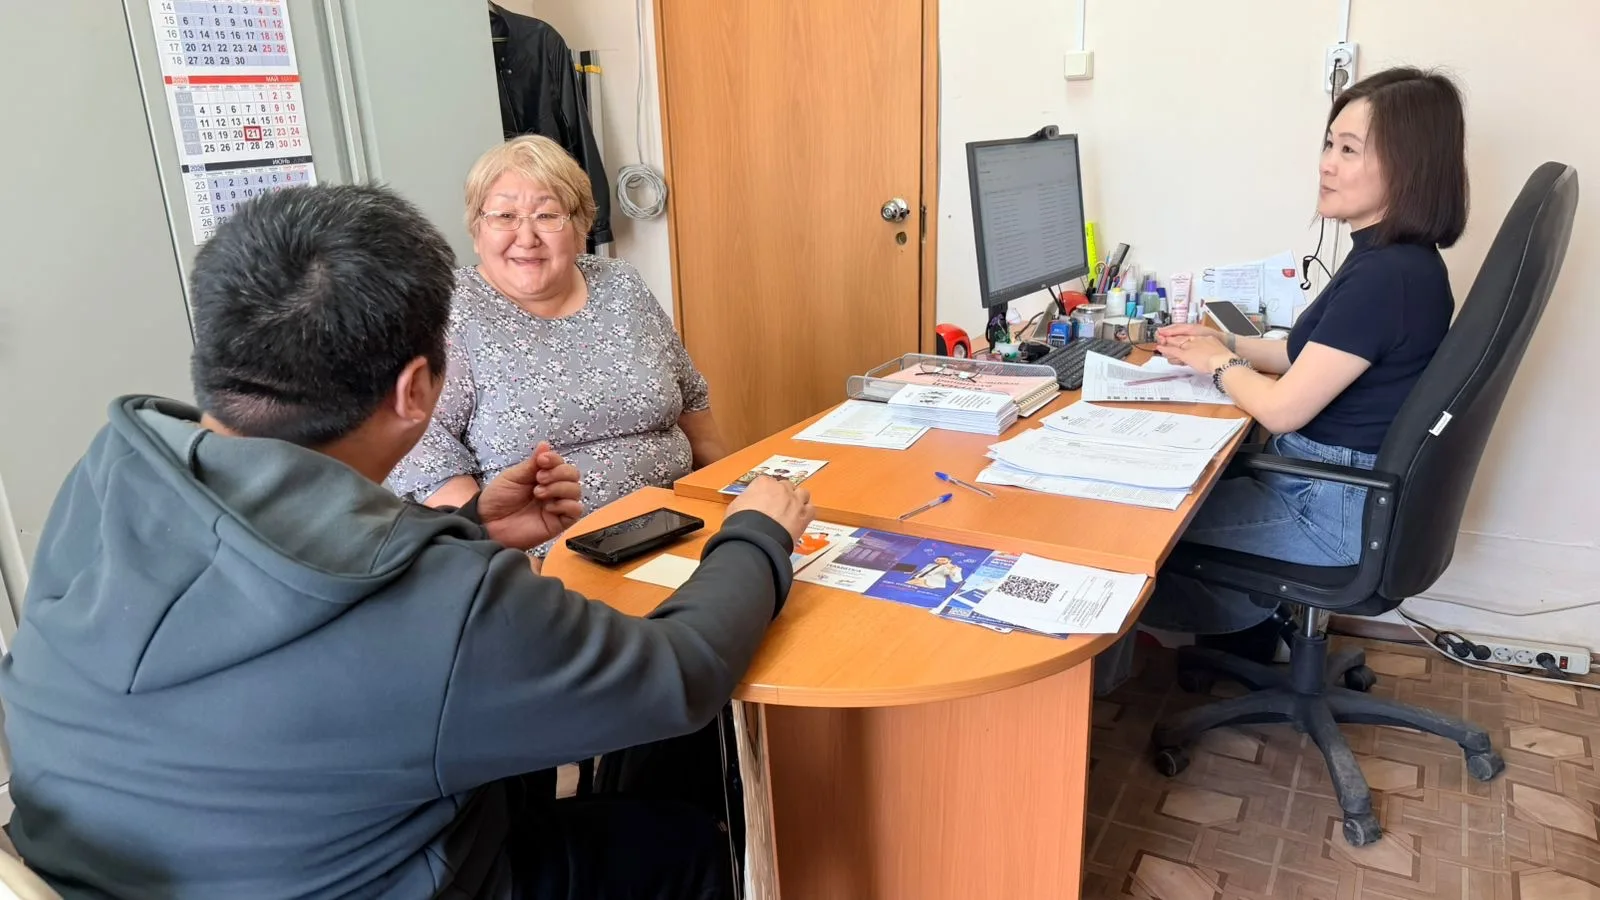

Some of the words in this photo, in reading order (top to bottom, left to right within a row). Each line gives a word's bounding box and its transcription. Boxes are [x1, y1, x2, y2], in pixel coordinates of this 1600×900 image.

[161, 2, 172, 11] 14
[213, 5, 217, 13] 1
[228, 6, 233, 14] 2
[243, 6, 248, 14] 3
[258, 7, 263, 16] 4
[272, 8, 278, 16] 5
[165, 15, 175, 25] 15
[183, 17, 189, 25] 6
[199, 17, 204, 25] 7
[215, 18, 220, 26] 8
[230, 18, 236, 26] 9
[243, 19, 253, 27] 10
[258, 19, 267, 28] 11
[273, 20, 282, 28] 12
[167, 29, 177, 38] 16
[183, 30, 194, 39] 13
[199, 30, 210, 39] 14
[215, 31, 225, 39] 15
[230, 31, 241, 39] 16
[245, 32, 255, 40] 17
[261, 32, 270, 40] 18
[274, 32, 284, 41] 19
[169, 43, 179, 52] 17
[186, 43, 196, 52] 20
[202, 44, 212, 52] 21
[217, 44, 228, 52] 22
[233, 44, 243, 52] 23
[248, 44, 258, 52] 24
[262, 44, 272, 52] 25
[276, 44, 286, 53] 26
[172, 56, 182, 65] 18
[188, 56, 198, 65] 27
[204, 56, 215, 65] 28
[220, 57, 230, 65] 29
[235, 57, 245, 65] 30
[259, 92, 263, 100] 1
[272, 92, 278, 100] 2
[286, 91, 291, 99] 3
[199, 106, 205, 114] 4
[216, 106, 221, 114] 5
[231, 105, 236, 113] 6
[246, 105, 251, 113] 7
[260, 104, 266, 112] 8
[274, 104, 279, 112] 9
[200, 119, 209, 128] 11
[216, 118, 226, 127] 12
[231, 118, 241, 126] 13
[246, 117, 256, 125] 14
[260, 116, 270, 124] 15
[275, 115, 284, 124] 16
[288, 115, 297, 123] 17
[202, 131, 213, 140] 18
[218, 131, 228, 139] 19
[233, 130, 243, 138] 20
[248, 129, 258, 138] 21
[263, 128, 272, 136] 22
[277, 128, 286, 136] 23
[290, 127, 300, 135] 24
[204, 144, 215, 153] 25
[220, 143, 231, 151] 26
[235, 142, 245, 150] 27
[250, 141, 260, 150] 28
[265, 140, 274, 149] 29
[279, 139, 288, 148] 30
[292, 139, 301, 147] 31
[195, 181, 206, 190] 23
[229, 179, 234, 187] 2
[272, 174, 278, 182] 5
[286, 173, 291, 181] 6
[197, 193, 208, 202] 24
[215, 192, 221, 200] 8
[243, 189, 253, 197] 10
[199, 206, 210, 214] 25
[215, 205, 226, 213] 15
[202, 218, 212, 227] 26
[217, 216, 227, 225] 22
[203, 230, 213, 238] 27
